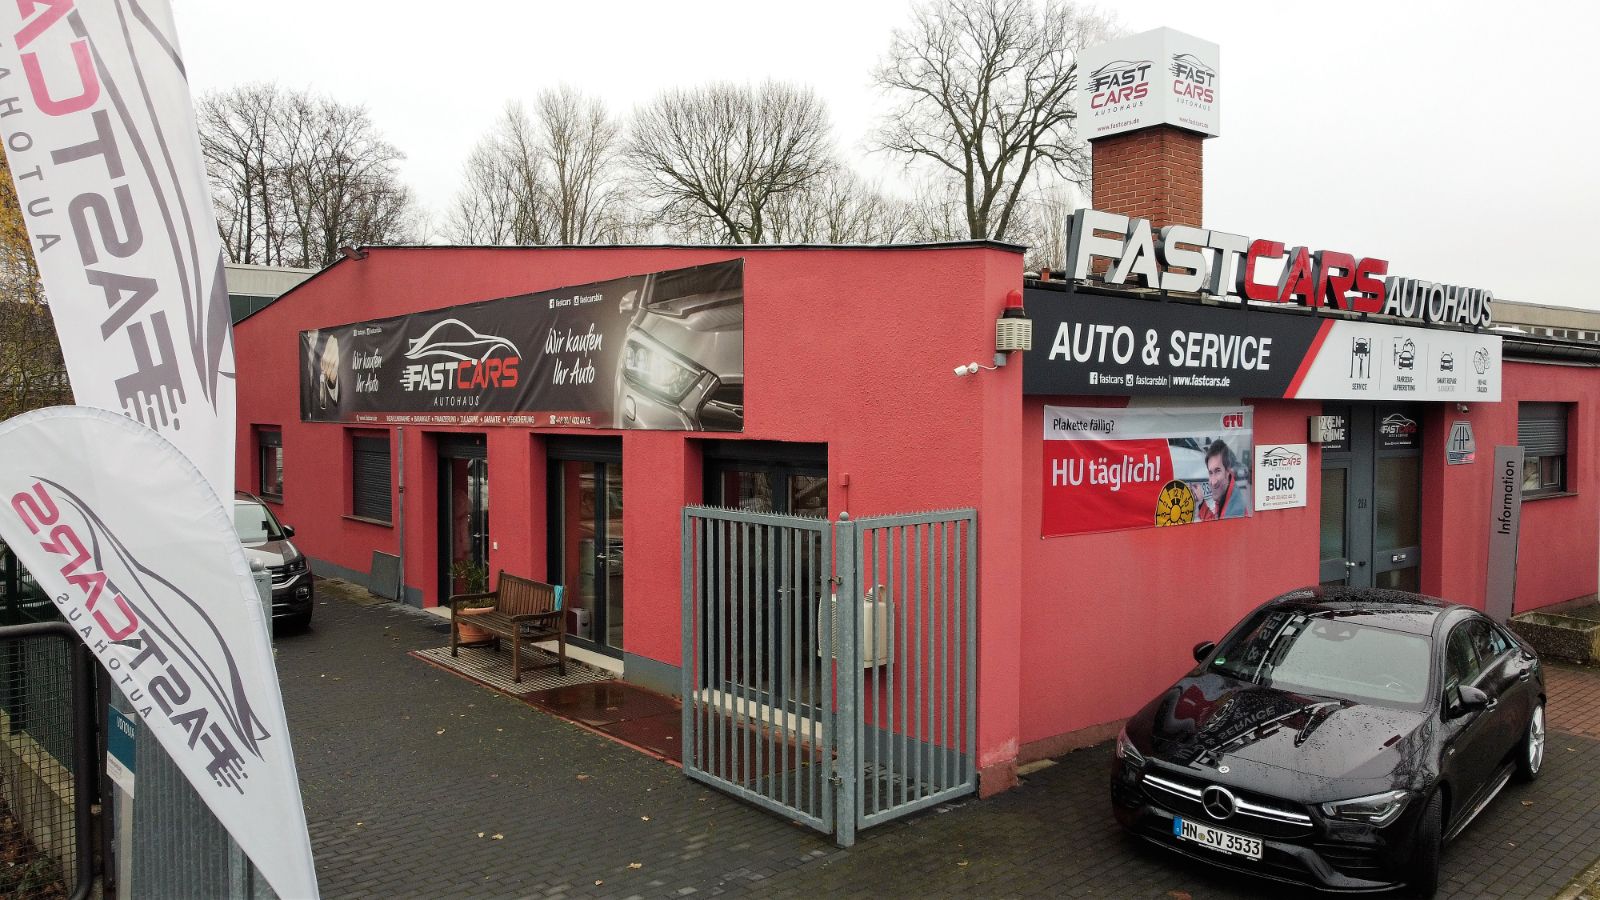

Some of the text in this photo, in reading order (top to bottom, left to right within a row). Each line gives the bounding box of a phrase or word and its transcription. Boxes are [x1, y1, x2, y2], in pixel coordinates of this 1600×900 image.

[1085, 64, 1152, 94] FAST
[1169, 62, 1216, 87] FAST
[1090, 82, 1149, 110] CARS
[1173, 79, 1214, 104] CARS
[1094, 101, 1144, 117] AUTOHAUS
[1176, 98, 1211, 112] AUTOHAUS
[1097, 118, 1140, 132] www.fastcars.de
[1068, 207, 1494, 328] FASTCARS AUTOHAUS
[545, 322, 603, 357] Wir kaufen
[1048, 321, 1273, 371] AUTO & SERVICE
[400, 356, 520, 392] FASTCARS
[552, 357, 596, 386] Ihr Auto
[1099, 373, 1230, 387] fastcars fastcarsbln www.fastcars.de
[1351, 383, 1368, 391] SERVICE
[433, 395, 480, 407] AUTOHAUS
[1053, 417, 1115, 434] Plakette fällig?
[1222, 411, 1244, 429] GTÜ
[1052, 453, 1161, 492] HU täglich!
[1260, 457, 1302, 467] FASTCARS
[1268, 474, 1295, 491] BÜRO
[1497, 459, 1515, 535] Information
[1182, 821, 1198, 839] HN
[1206, 829, 1223, 847] SV
[1226, 835, 1260, 856] 3533
